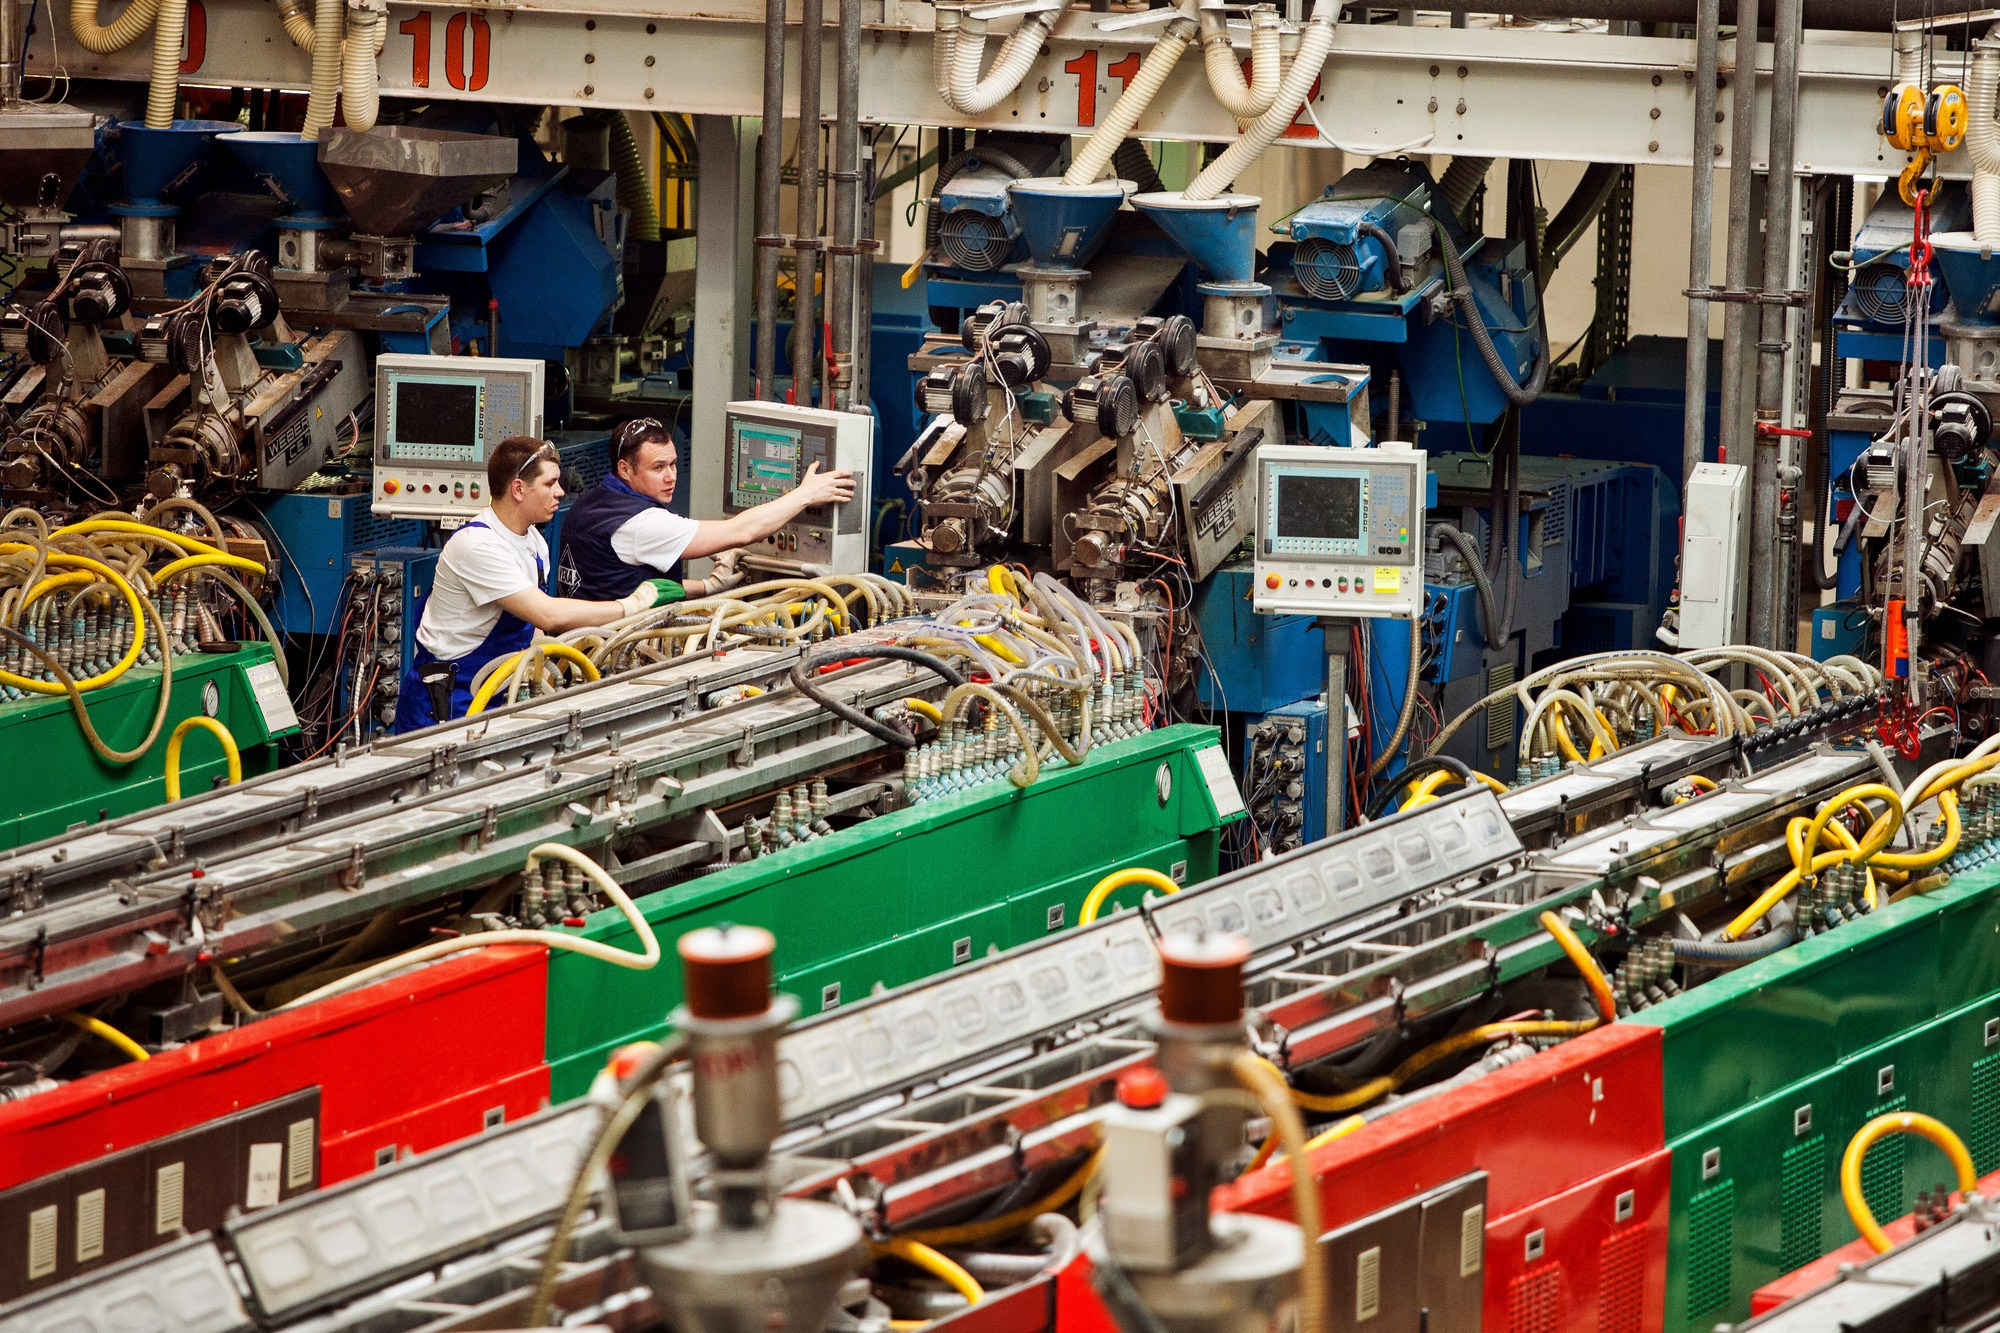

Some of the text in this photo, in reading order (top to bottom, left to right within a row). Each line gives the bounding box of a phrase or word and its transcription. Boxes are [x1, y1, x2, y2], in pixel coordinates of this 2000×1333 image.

[400, 11, 491, 91] 10
[269, 415, 309, 456] WEBER
[1199, 489, 1233, 530] WEBER
